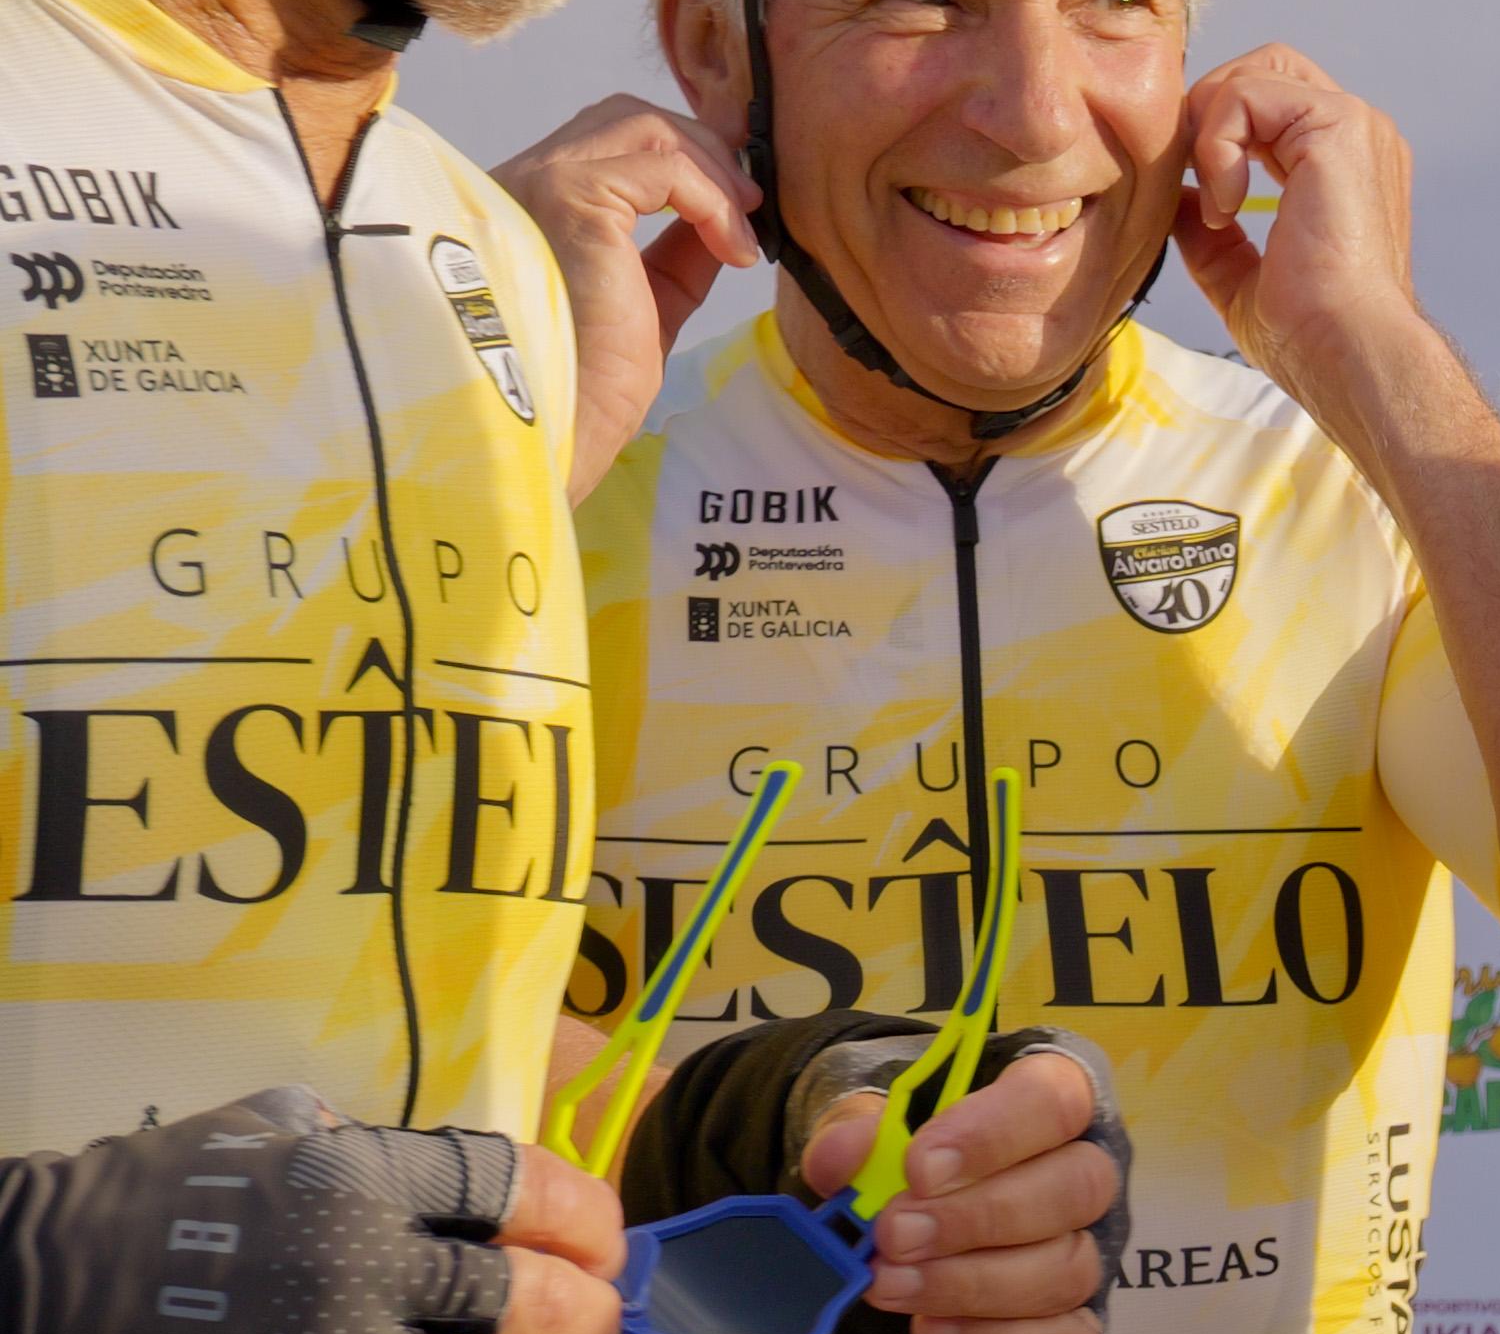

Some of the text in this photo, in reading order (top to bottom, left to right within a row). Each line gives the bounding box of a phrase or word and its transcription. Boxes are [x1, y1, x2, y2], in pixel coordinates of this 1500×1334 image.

[0, 163, 183, 230] GOBIK
[91, 259, 207, 282] Deputación
[98, 280, 215, 302] Pontevedra
[81, 340, 186, 363] XUNTA
[89, 369, 249, 395] DE GALICIA
[700, 485, 840, 525] GOBIK
[748, 544, 844, 559] Deputación
[151, 527, 543, 617] GRUPO
[748, 559, 845, 571] Pontevedra
[727, 600, 801, 617] XUNTA
[727, 620, 853, 639] DE GALICIA
[728, 739, 1162, 796] GRUPO
[1366, 1131, 1384, 1299] SERVICIOS
